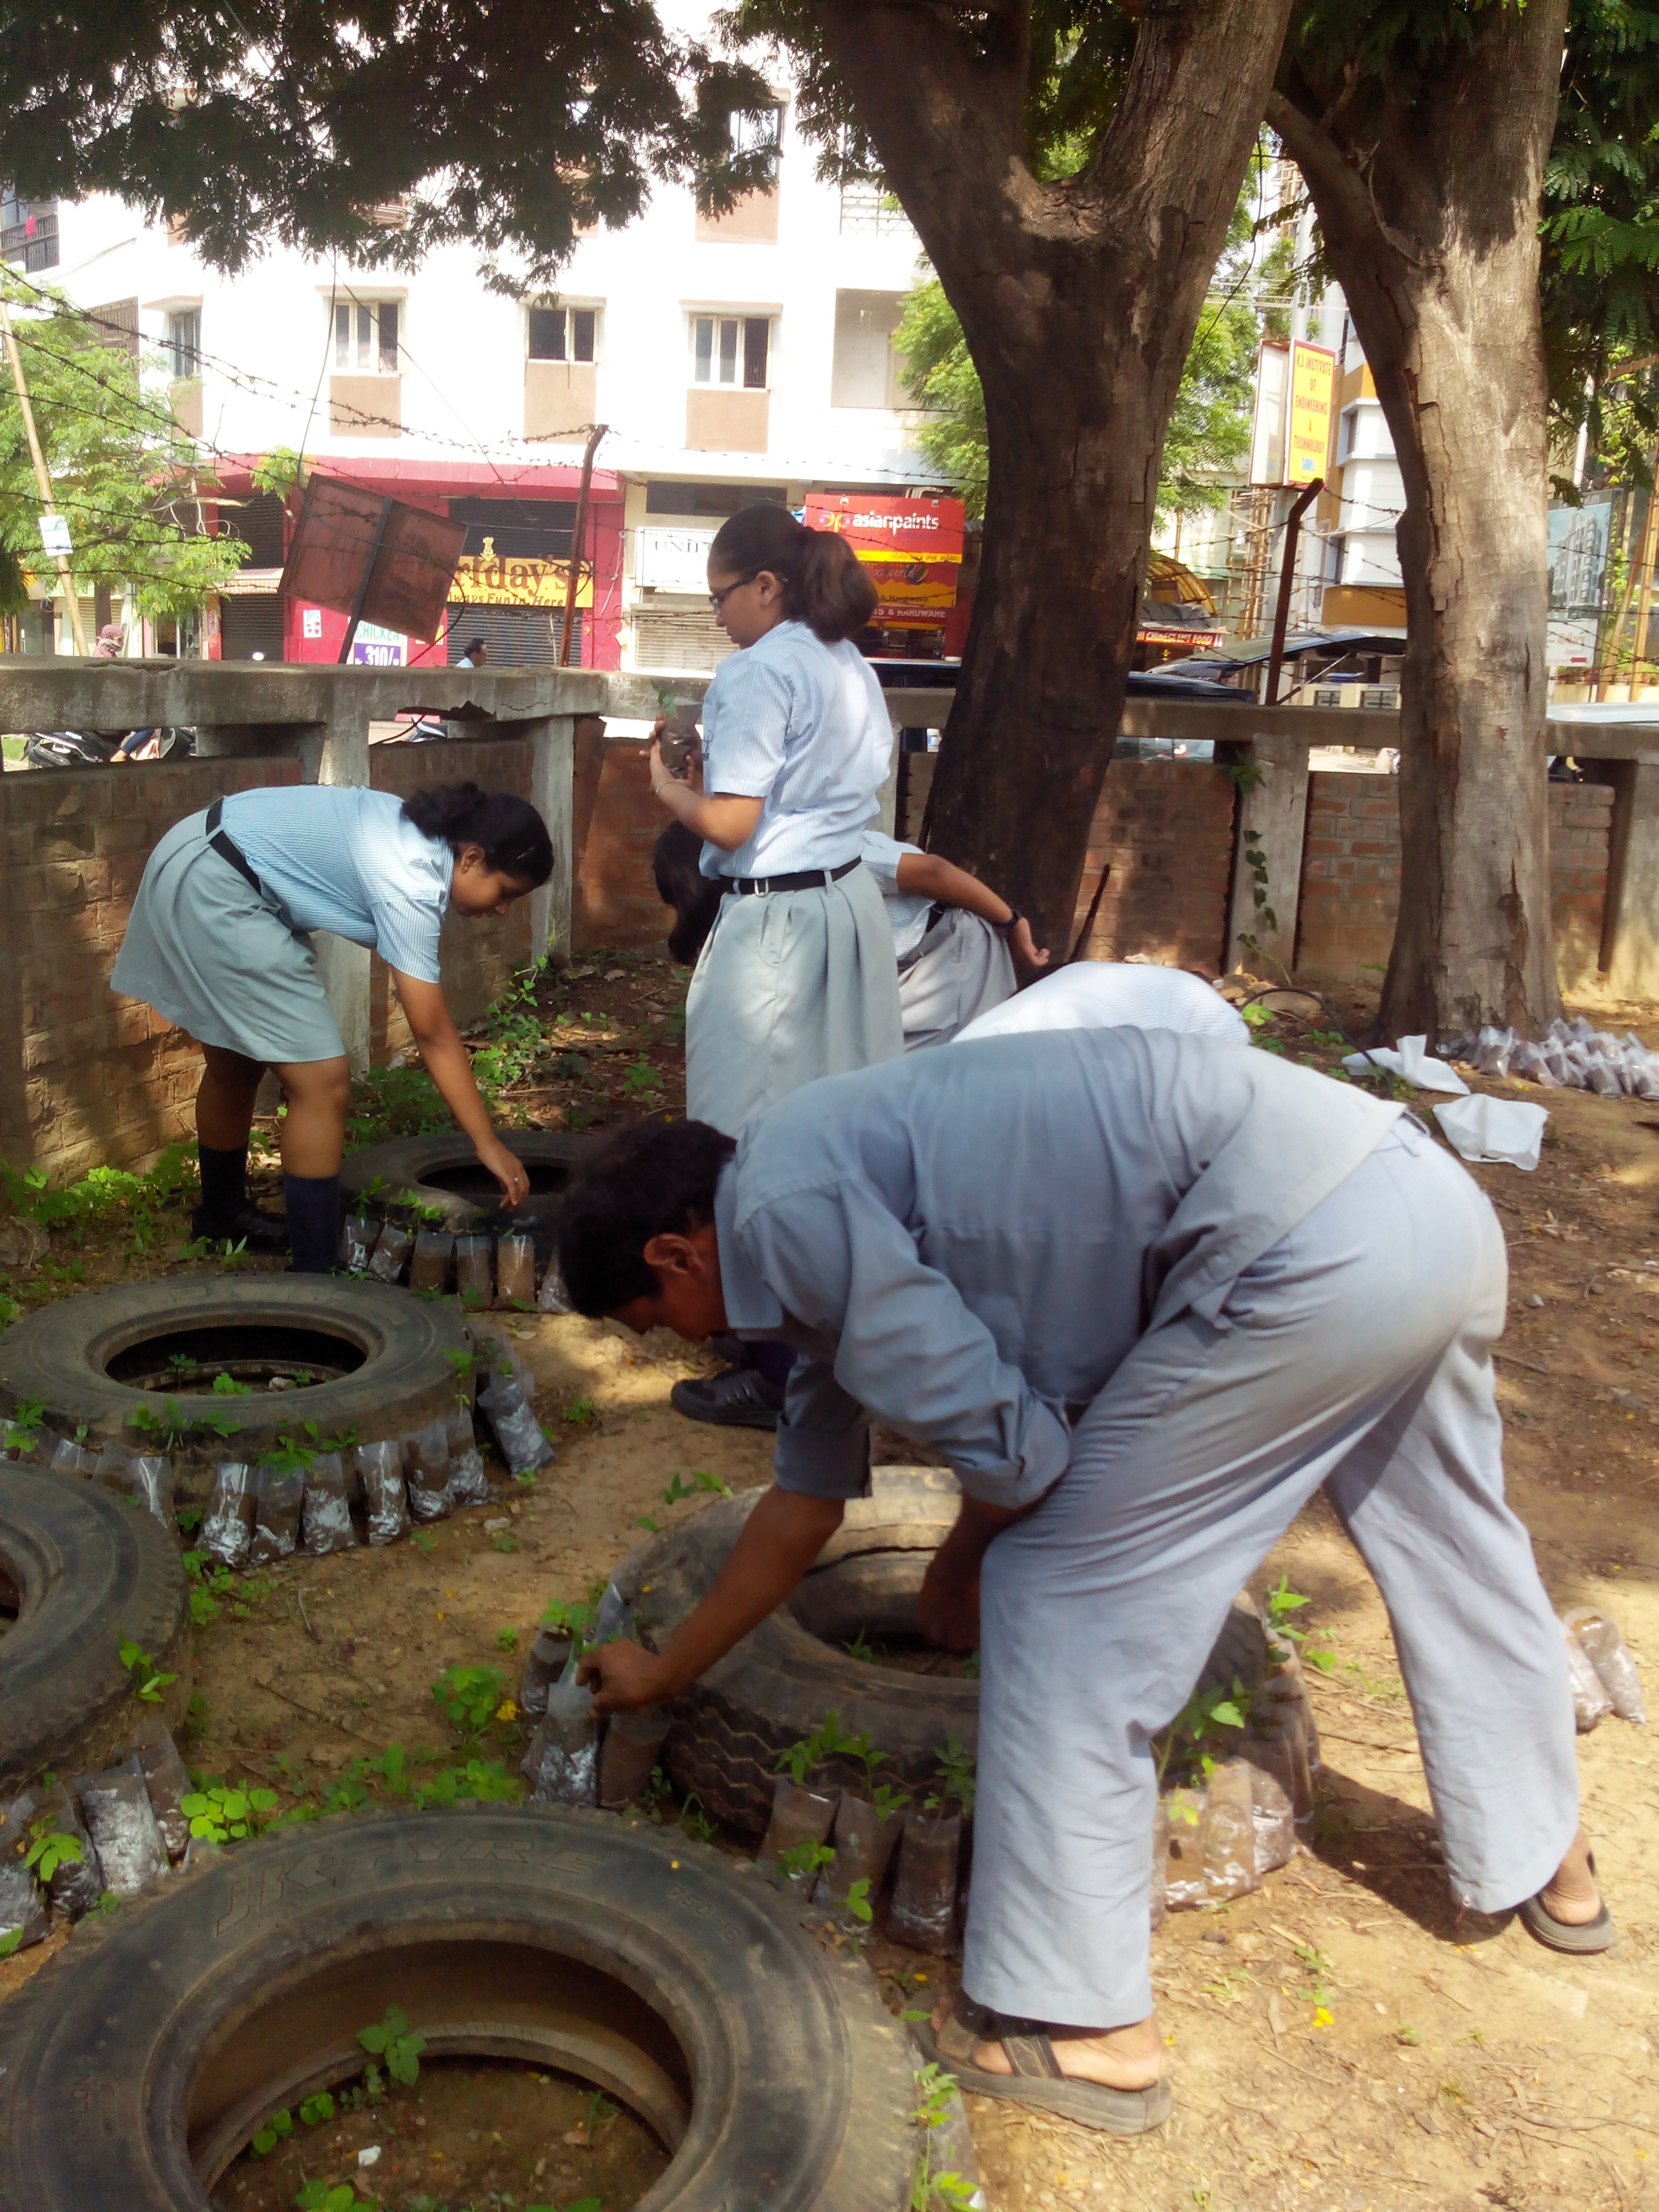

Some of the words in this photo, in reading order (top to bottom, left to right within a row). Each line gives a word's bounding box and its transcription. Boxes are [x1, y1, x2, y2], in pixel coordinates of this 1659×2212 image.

[1306, 356, 1331, 376] INSTITUTE
[1295, 394, 1327, 415] ENGINEERING
[1294, 435, 1325, 454] TECHNOLOGY
[853, 510, 940, 535] asianpaints
[451, 556, 568, 597] riday's
[449, 592, 483, 603] lways
[533, 596, 563, 607] Here
[356, 621, 400, 642] CHICKEN
[1192, 634, 1212, 645] FOOD
